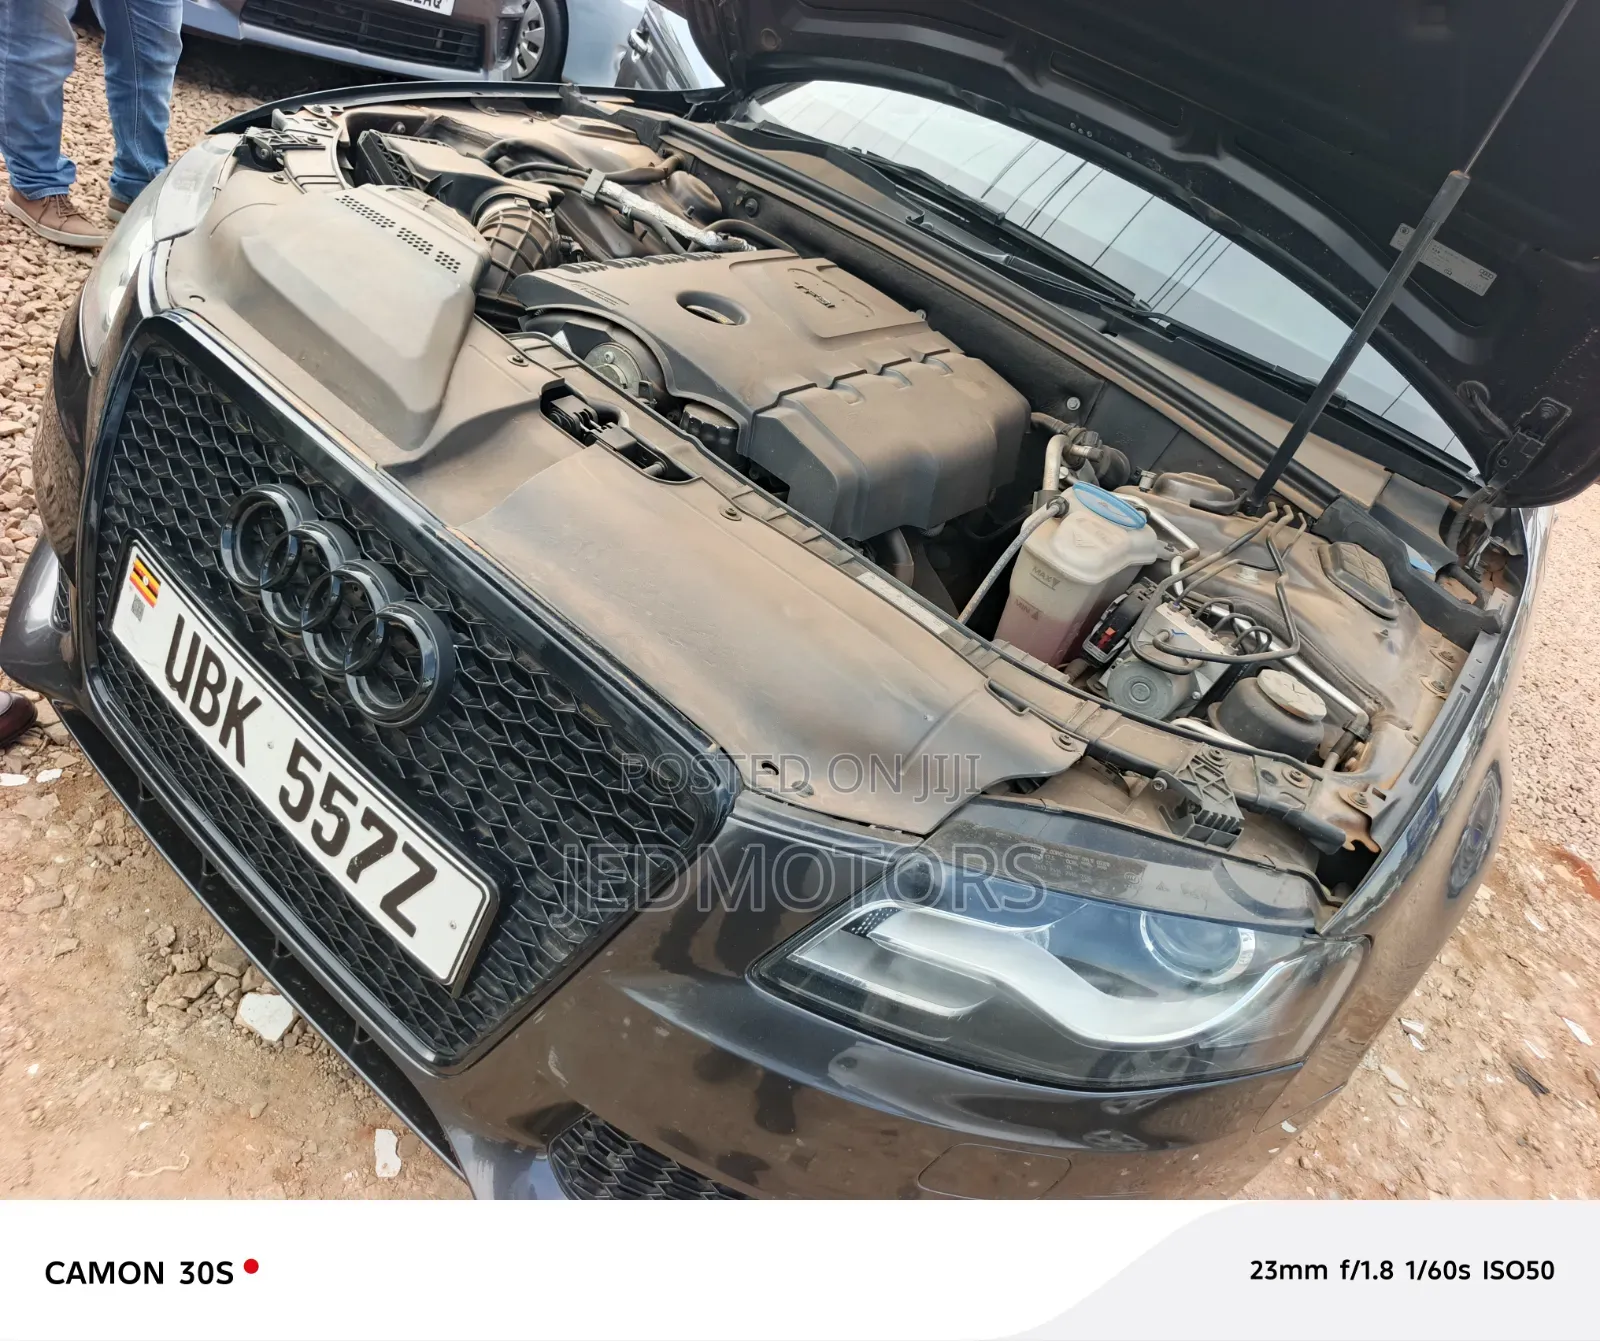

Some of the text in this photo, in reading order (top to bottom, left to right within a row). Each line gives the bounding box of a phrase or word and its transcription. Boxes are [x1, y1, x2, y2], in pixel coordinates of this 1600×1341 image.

[1032, 566, 1053, 582] MAX
[1014, 598, 1030, 613] MIN
[164, 613, 438, 938] UBK 557Z
